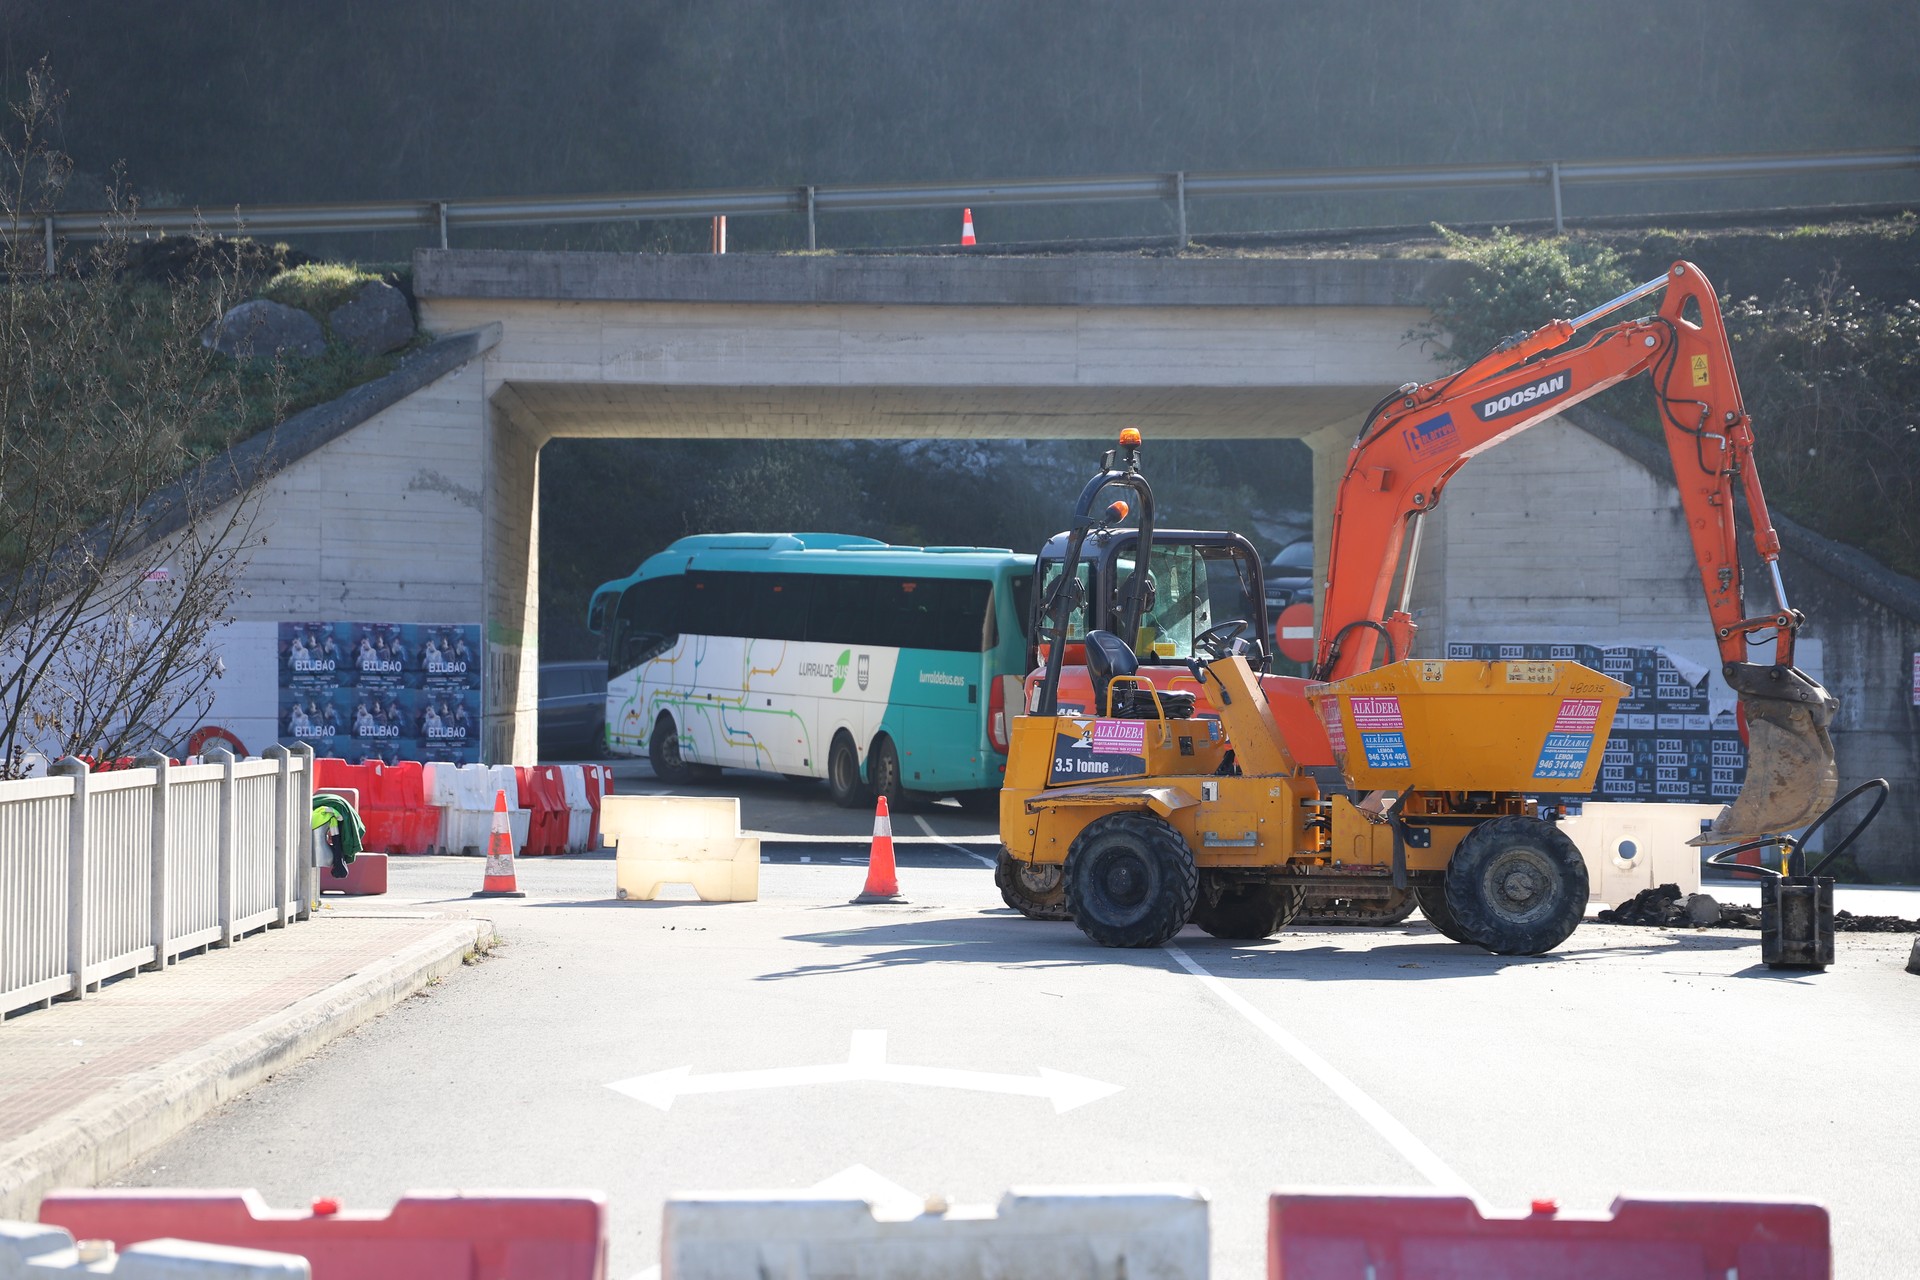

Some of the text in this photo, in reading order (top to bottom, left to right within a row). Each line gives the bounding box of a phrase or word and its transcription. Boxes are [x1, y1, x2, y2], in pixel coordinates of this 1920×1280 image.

[1484, 375, 1564, 417] DOOSAN
[1452, 647, 1471, 656] DELI
[1502, 647, 1522, 656] DELI
[1552, 648, 1574, 657] DELI
[295, 660, 335, 671] BILBAO
[362, 661, 402, 672] BILBAO
[428, 662, 466, 673] BILBAO
[1605, 660, 1632, 669] RIUM
[799, 662, 848, 678] LURRALDEBUS
[919, 669, 965, 687] lurraldebus.eus
[1659, 674, 1678, 683] TRE
[1570, 683, 1605, 694] 480035
[1659, 688, 1688, 697] MENS
[1353, 700, 1400, 714] ALKIDEBA
[1559, 703, 1599, 717] ALKIDEBA
[295, 725, 335, 737] BILBAO
[359, 725, 399, 737] BILBAO
[428, 726, 466, 738] BILBAO
[1094, 723, 1143, 739] ALKIDEBA
[1547, 738, 1590, 747] ALKIZABAL
[1606, 741, 1627, 750] DELI
[1659, 741, 1680, 750] DELI
[1713, 742, 1736, 751] DELI
[1368, 753, 1380, 761] 946
[1381, 753, 1393, 761] 314
[1605, 754, 1632, 763] RIUM
[1659, 755, 1686, 764] RIUM
[1713, 756, 1742, 766] RIUM
[1055, 758, 1109, 773] 3.5 tonne
[1539, 760, 1584, 770] 946 314 406
[1605, 768, 1623, 778] TRE
[1659, 769, 1677, 778] TRE
[1713, 770, 1733, 780] TRE
[1605, 782, 1634, 791] MENS
[1659, 783, 1688, 792] MENS
